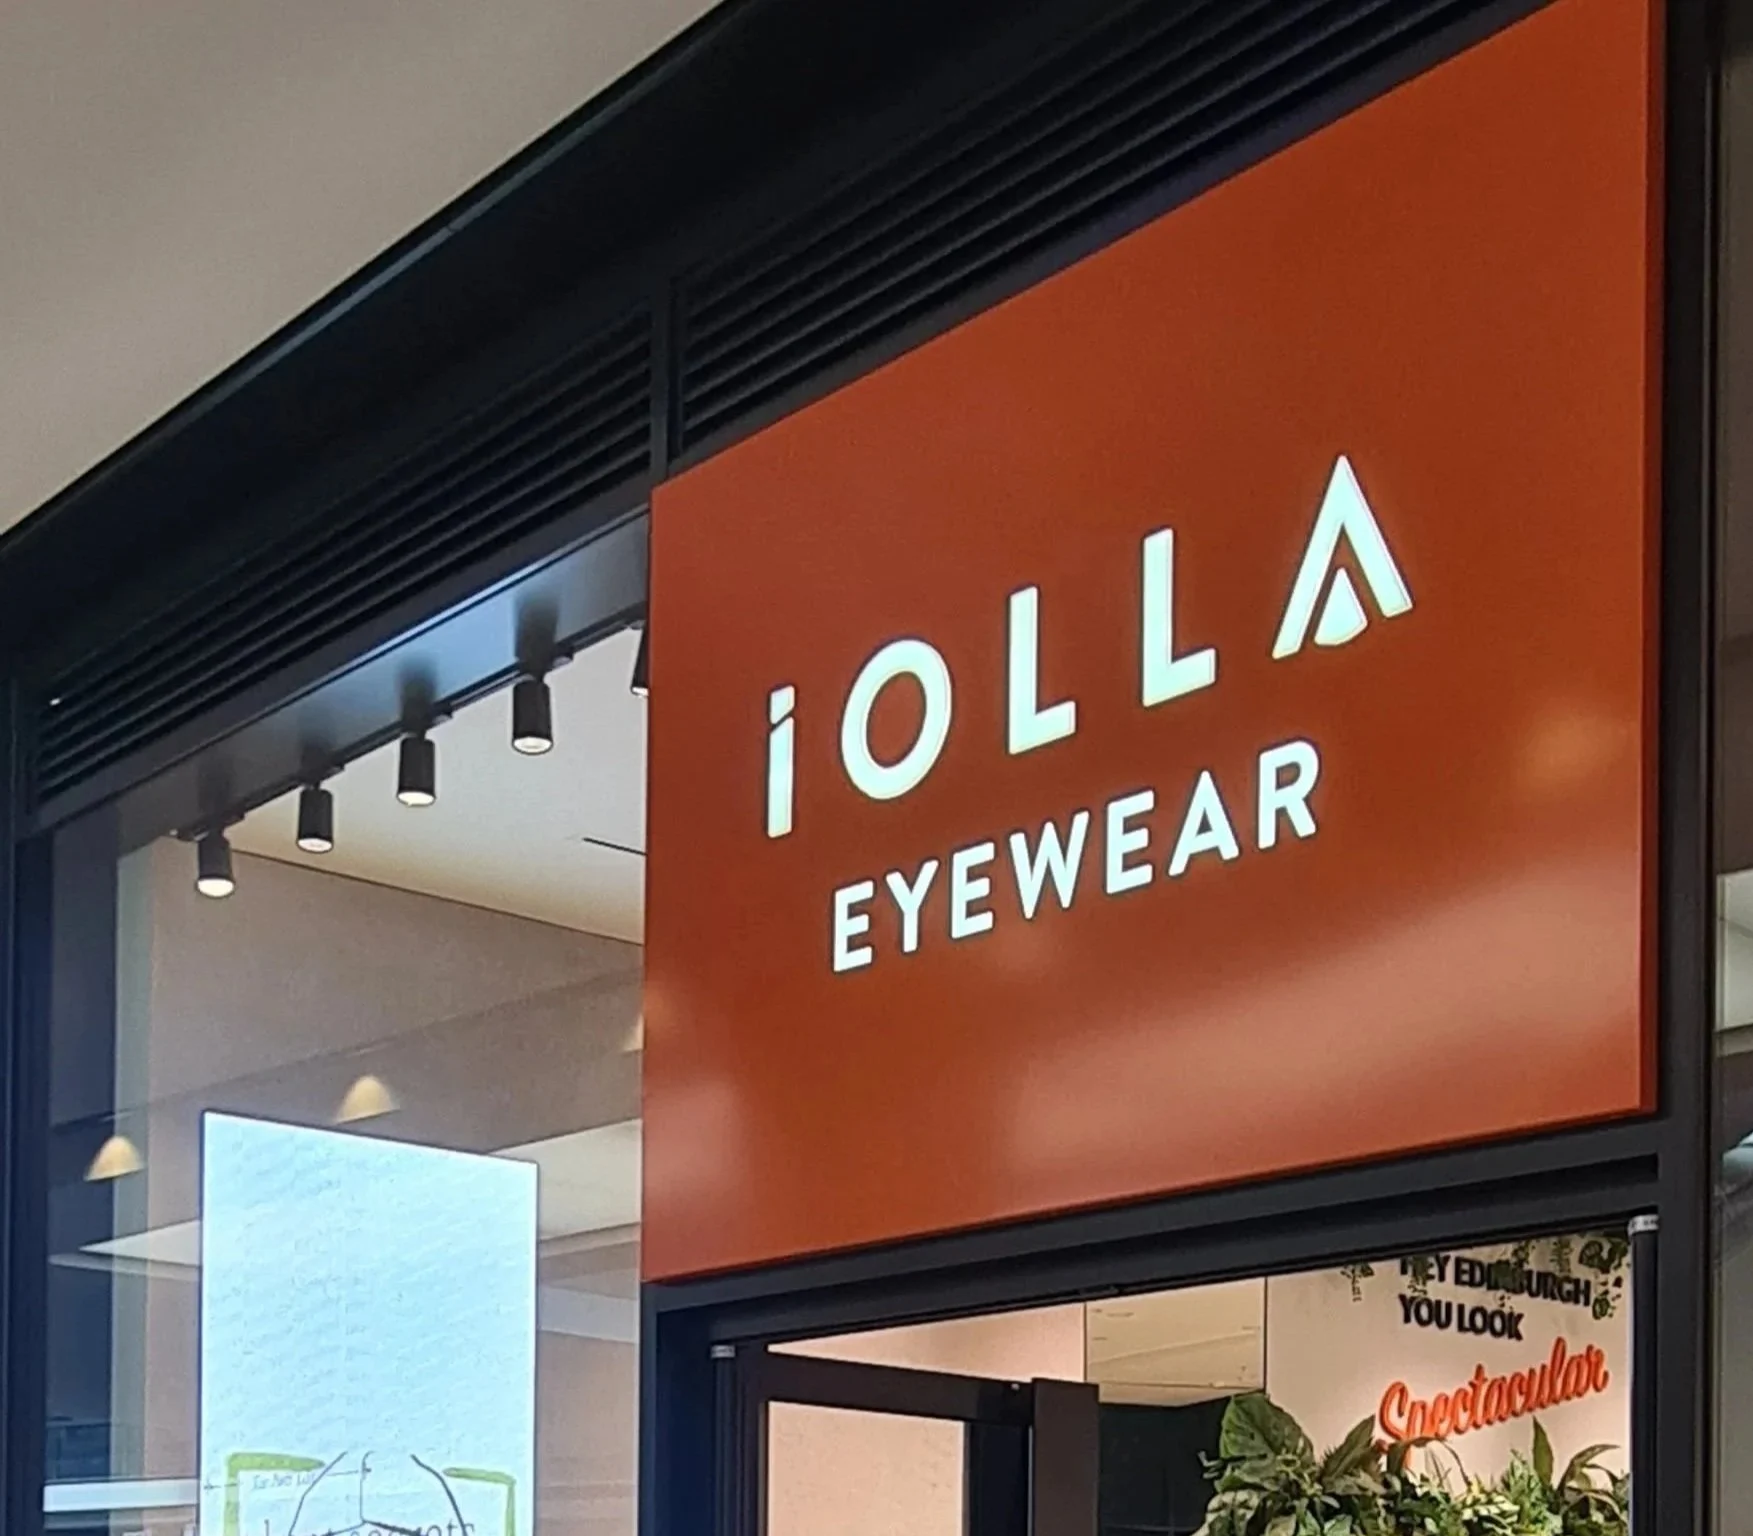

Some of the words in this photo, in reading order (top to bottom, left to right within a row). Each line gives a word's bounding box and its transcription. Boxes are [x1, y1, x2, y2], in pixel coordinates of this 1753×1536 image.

[832, 739, 1320, 973] EYEWEAR
[1398, 1293, 1452, 1329] YOU
[1457, 1303, 1525, 1341] LOOK
[1454, 1255, 1592, 1307] EDIURGH
[1379, 1335, 1610, 1468] Spectacular
